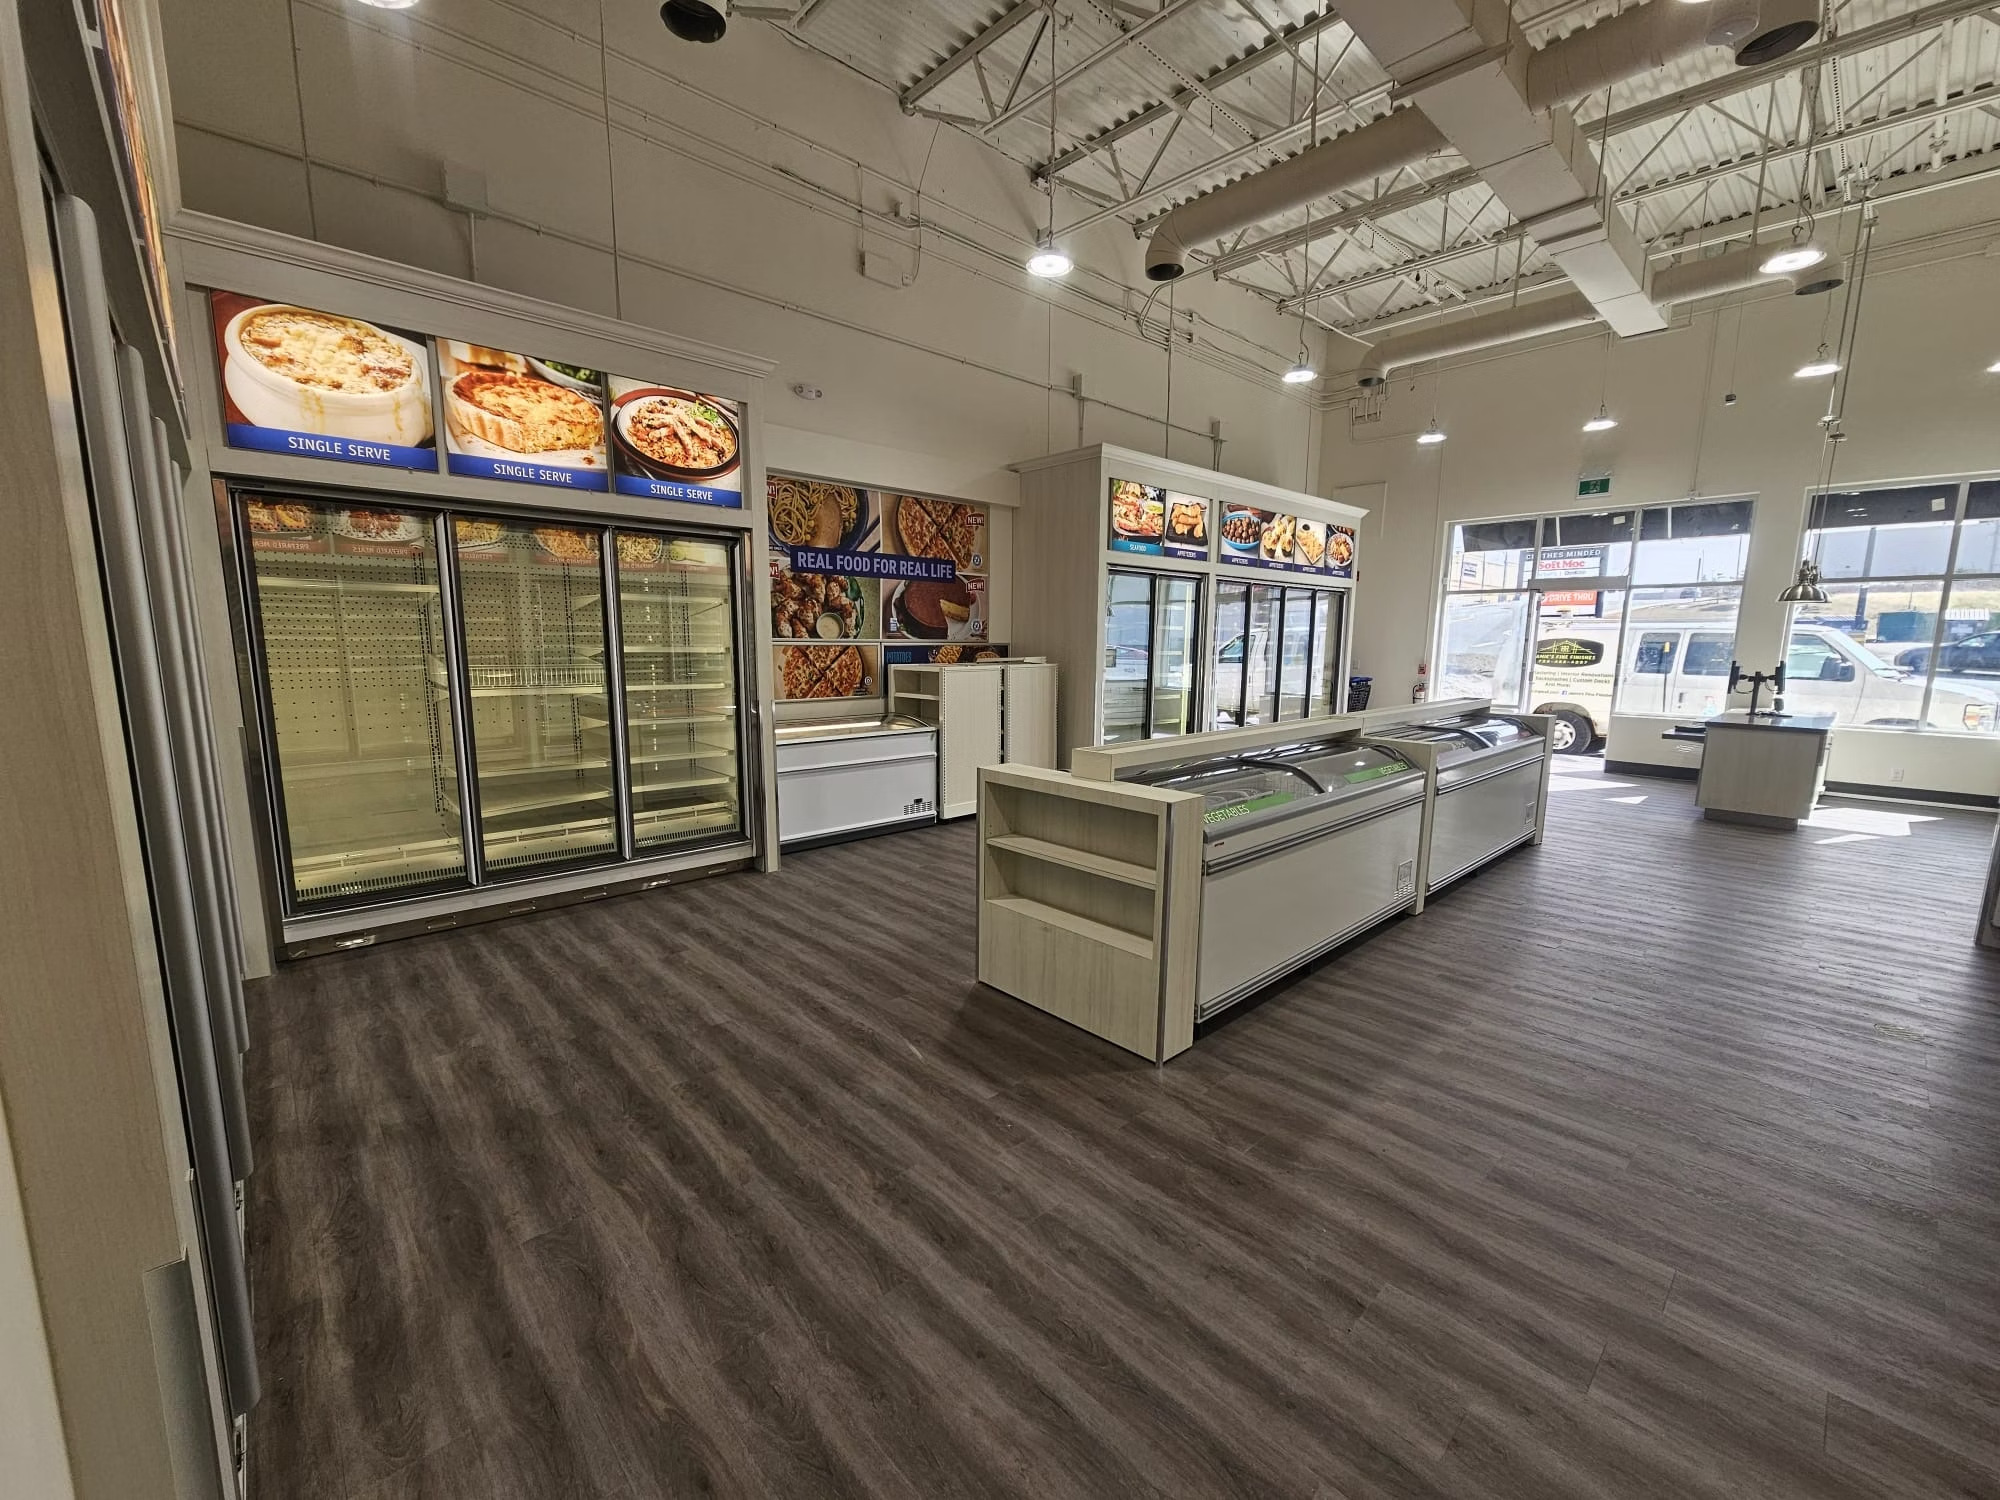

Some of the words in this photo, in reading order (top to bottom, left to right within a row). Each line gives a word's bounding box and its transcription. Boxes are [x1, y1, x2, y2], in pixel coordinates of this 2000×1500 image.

[288, 436, 342, 454] SINGLE
[348, 444, 391, 460] SERVE
[494, 464, 535, 478] SINGLE
[540, 470, 572, 483] SERVE
[650, 484, 683, 497] SINGLE
[686, 489, 713, 500] SERVE
[967, 516, 984, 524] NEW!
[1566, 549, 1600, 558] MINDED
[797, 552, 834, 570] REAL
[836, 554, 871, 572] FOOD
[873, 558, 897, 574] FOR
[900, 561, 928, 577] REAL
[930, 564, 952, 579] LIFE
[1562, 559, 1585, 568] Moc
[968, 582, 984, 590] NEW!
[1550, 593, 1572, 601] DRIVE
[1573, 592, 1594, 600] THRU
[1379, 762, 1408, 776] VEGETABLES
[1204, 805, 1250, 823] VEGETABLES
